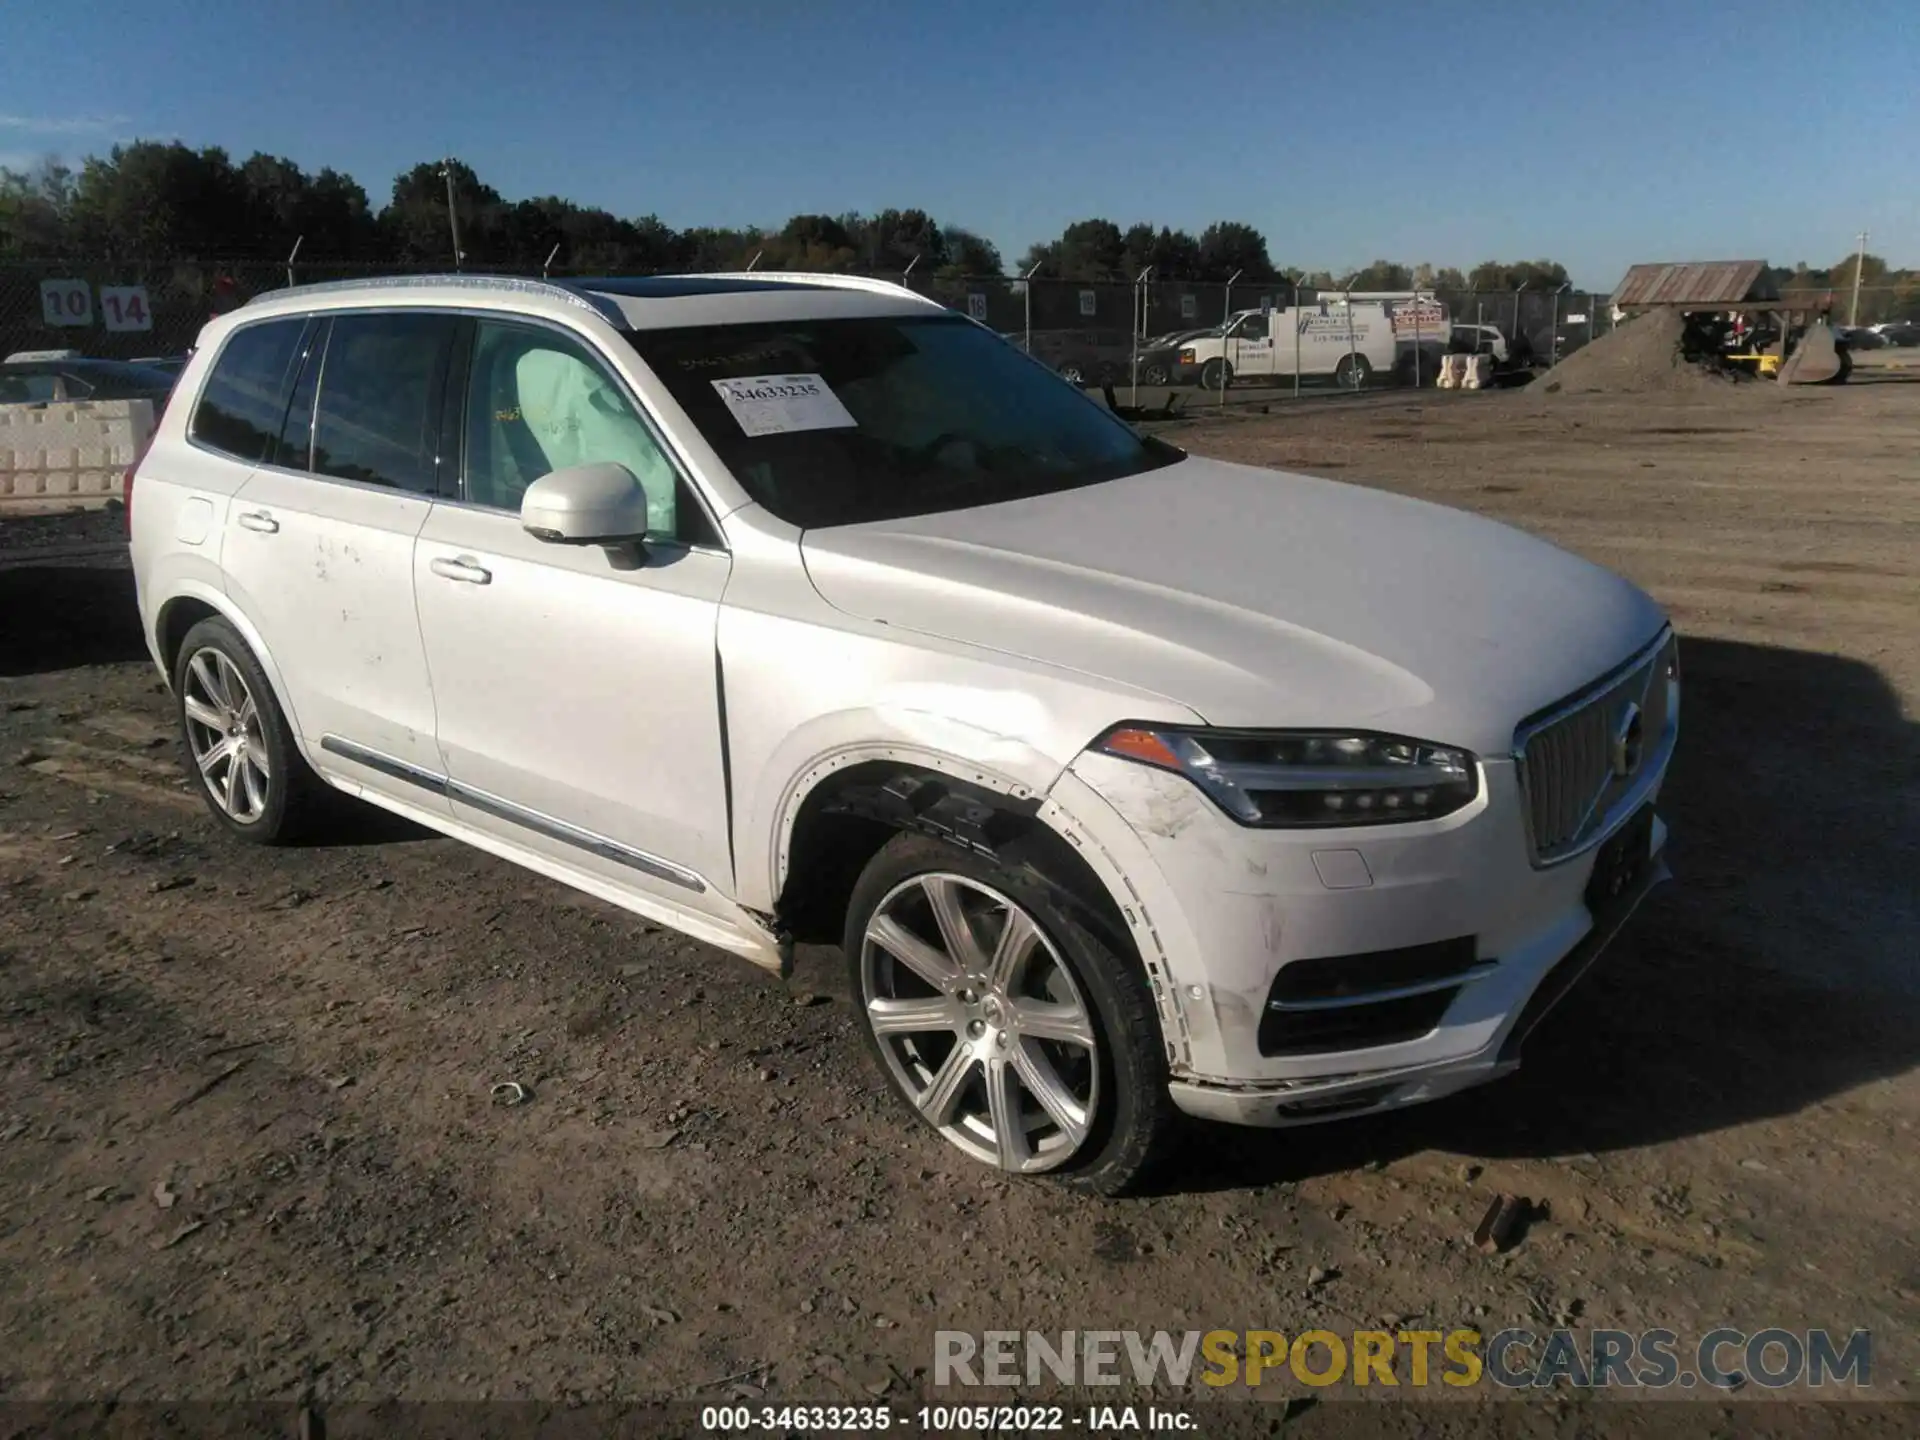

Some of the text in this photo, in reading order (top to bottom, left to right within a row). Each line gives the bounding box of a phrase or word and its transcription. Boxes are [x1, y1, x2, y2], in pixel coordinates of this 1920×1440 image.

[45, 289, 87, 317] 10
[104, 294, 148, 325] 14
[731, 384, 821, 402] 34633235
